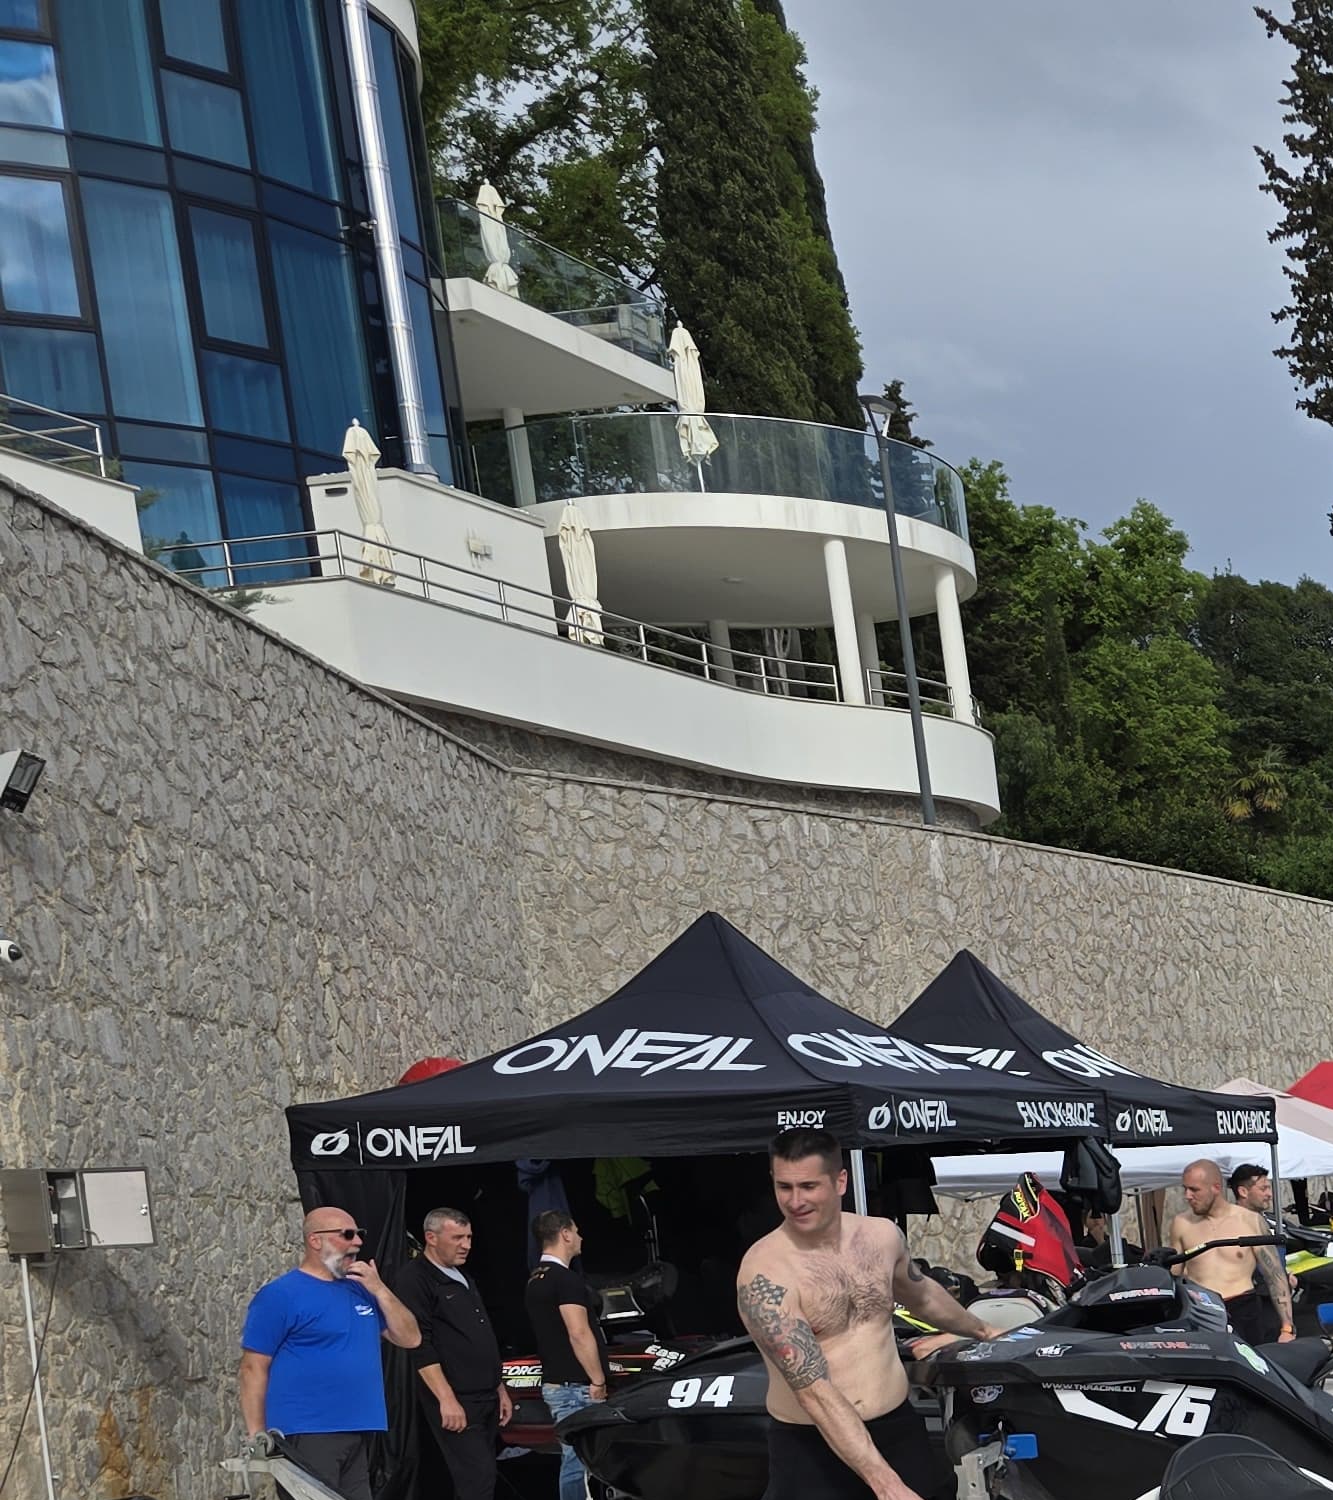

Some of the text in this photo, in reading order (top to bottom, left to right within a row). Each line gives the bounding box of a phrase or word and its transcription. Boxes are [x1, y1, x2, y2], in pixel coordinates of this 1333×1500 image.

[777, 1110, 827, 1126] ENJOY
[1016, 1101, 1100, 1128] ENJOY RIDE
[1216, 1111, 1249, 1135] ENJOY
[1251, 1110, 1274, 1134] RIDE
[667, 1375, 735, 1409] 94
[1137, 1379, 1217, 1438] 76
